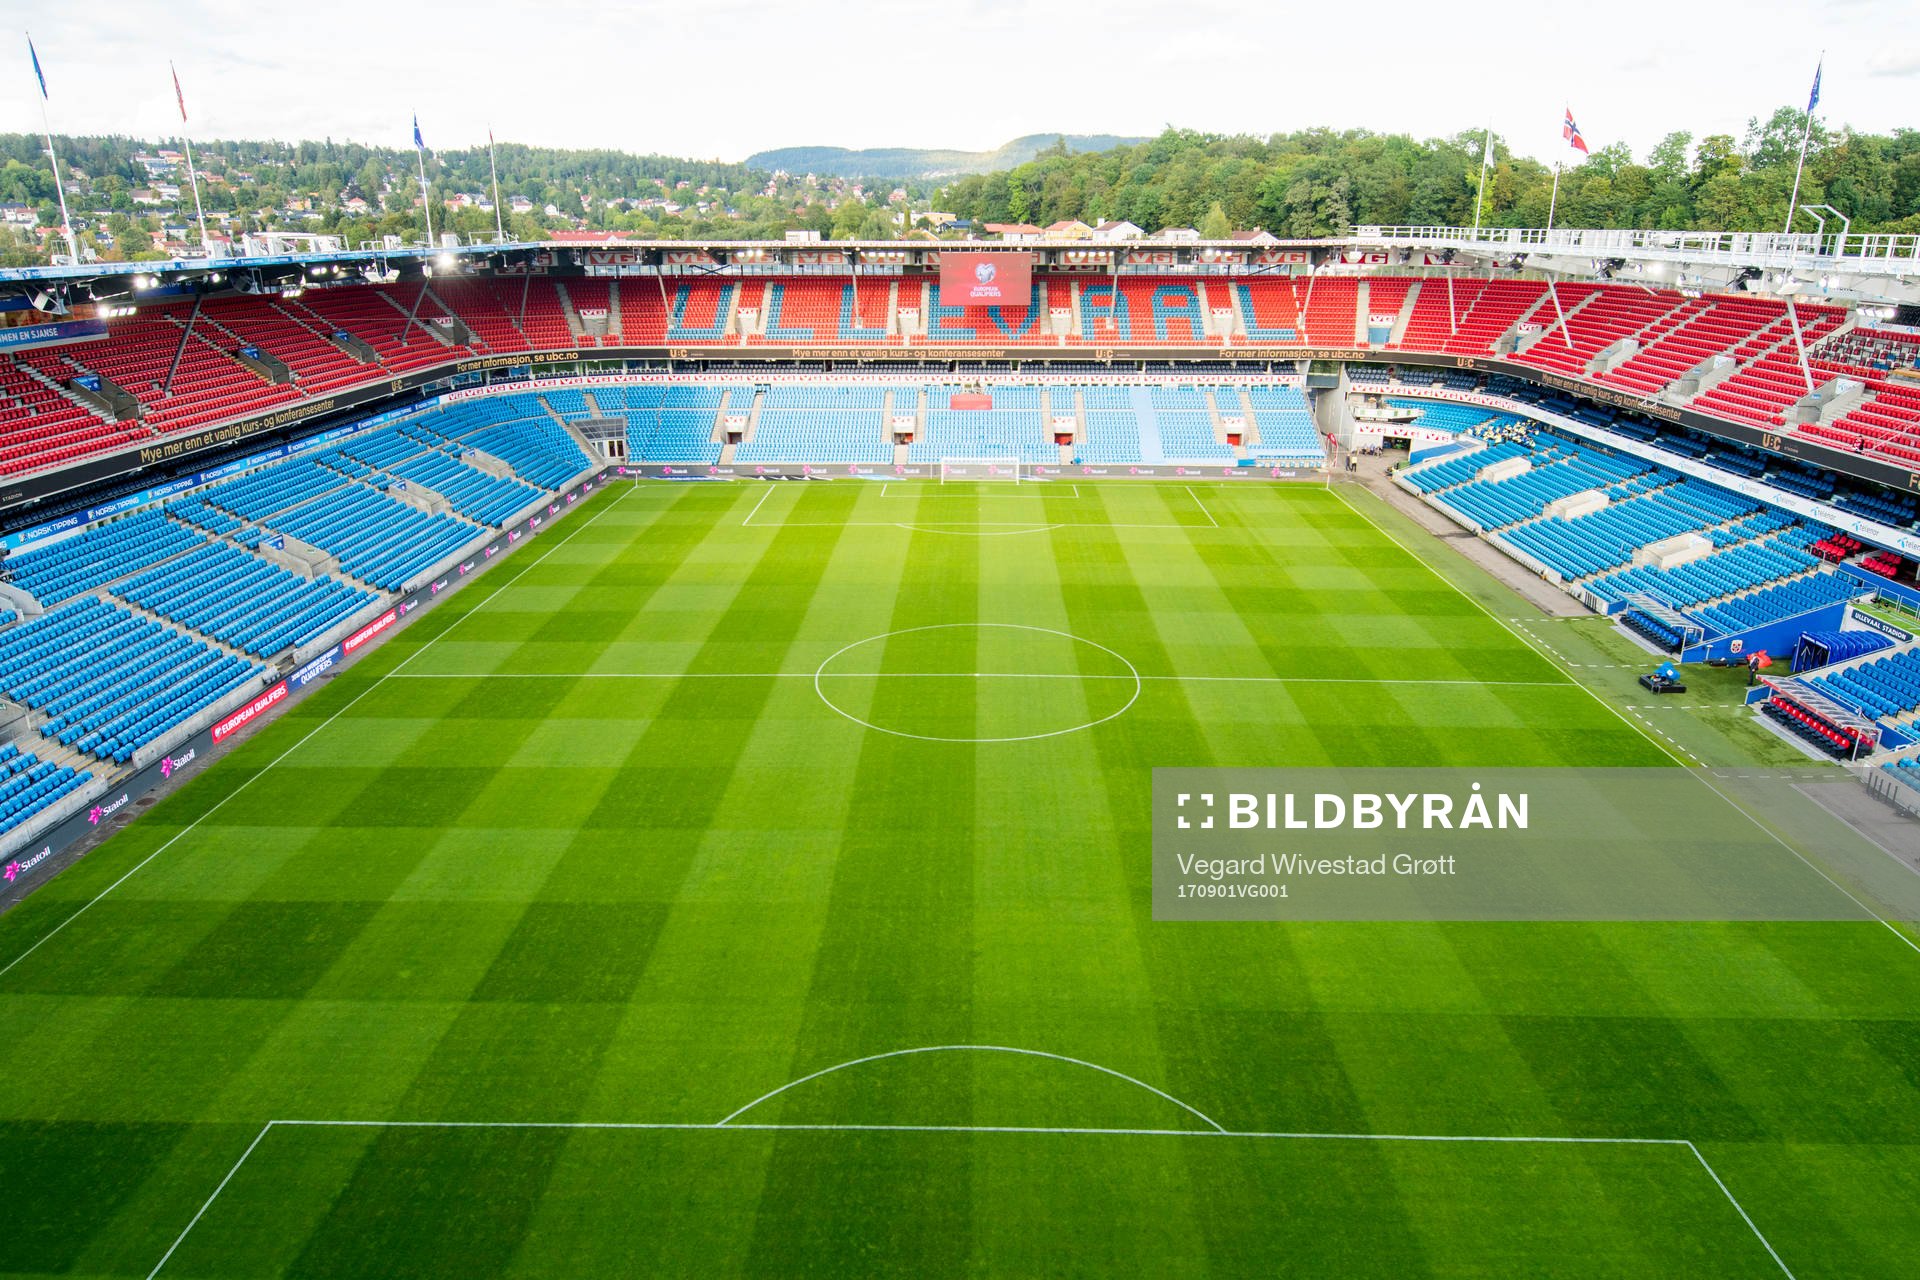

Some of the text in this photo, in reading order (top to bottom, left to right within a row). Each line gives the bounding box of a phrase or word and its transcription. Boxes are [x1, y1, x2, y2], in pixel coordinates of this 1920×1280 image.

[590, 253, 635, 264] VG
[668, 252, 712, 264] VG
[799, 252, 843, 264] VG
[1130, 252, 1172, 264] VG
[1261, 252, 1306, 264] VG
[20, 331, 29, 340] EN
[31, 328, 58, 339] SJANSE
[457, 363, 467, 372] For
[468, 361, 481, 370] mer
[546, 352, 578, 361] ubc.no
[792, 350, 810, 359] Mye
[862, 350, 888, 359] vanlig
[1219, 350, 1236, 358] For
[1332, 350, 1365, 359] ubc.no
[1542, 373, 1552, 384] Mye
[1553, 378, 1563, 386] mer
[1564, 380, 1573, 389] enn
[1574, 382, 1580, 391] et
[1581, 384, 1597, 397] vanlig
[1615, 394, 1622, 405] og
[140, 399, 334, 463] Mye mer enn et vanlig kurs- og konferansesenter
[155, 479, 193, 496] NORSK TIPPING
[95, 497, 139, 516] NORSK TIPPING
[27, 517, 78, 539] NORSK TIPPING
[1860, 523, 1879, 536] telenor
[1855, 613, 1906, 640] ULLEVAAL STADION
[301, 658, 332, 684] QUALIFIERS
[222, 685, 286, 734] EUROPEAN QUALIFIERS
[173, 749, 195, 770] Statoil
[103, 794, 128, 816] Statoil
[21, 846, 51, 871] Statoil
